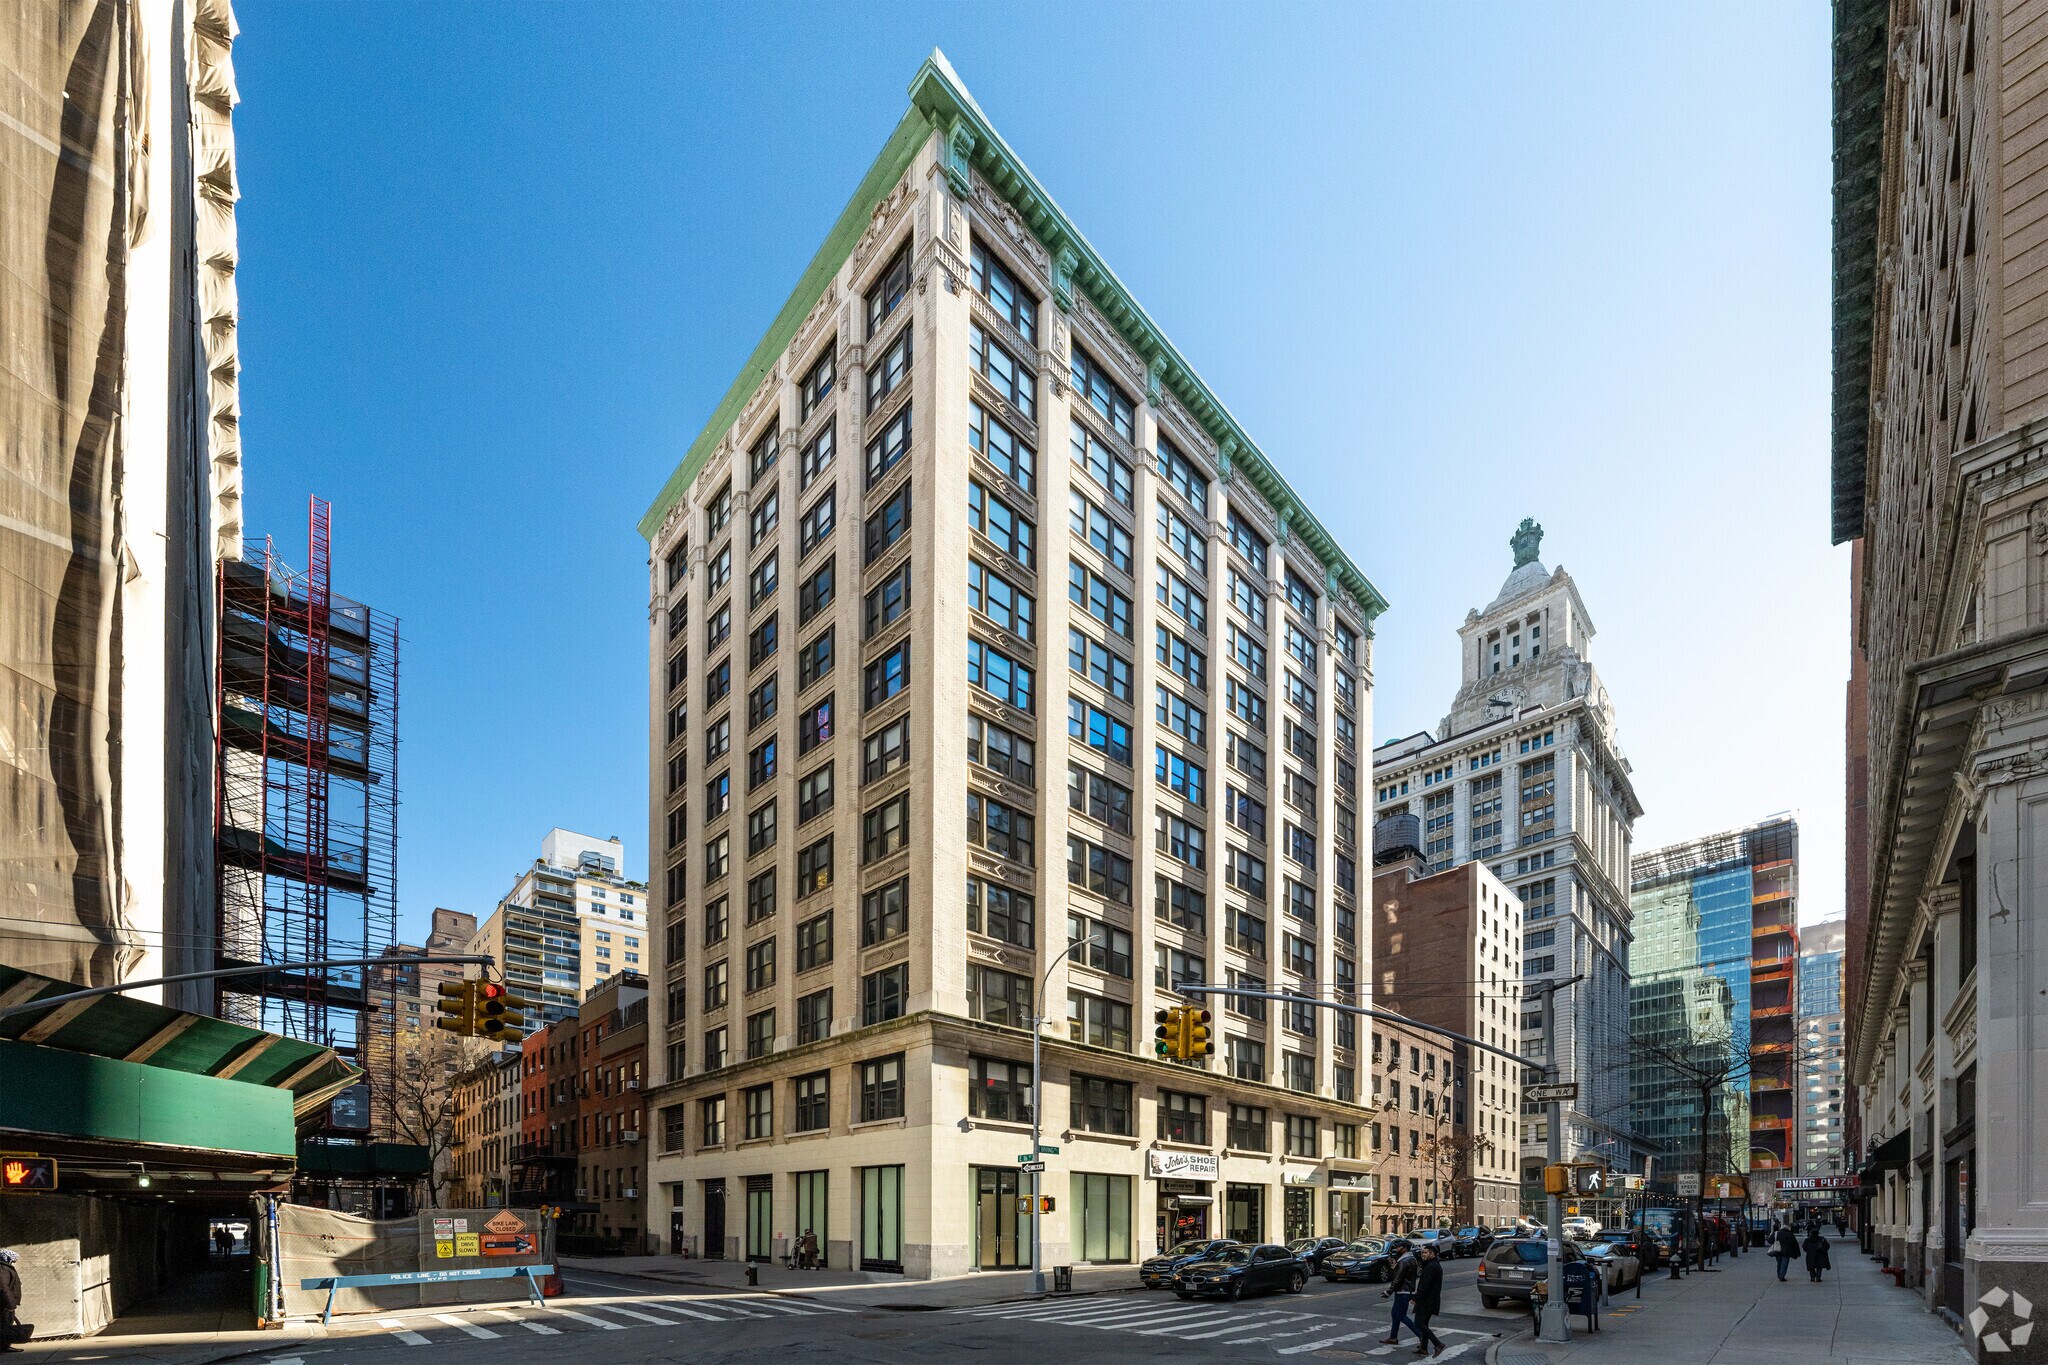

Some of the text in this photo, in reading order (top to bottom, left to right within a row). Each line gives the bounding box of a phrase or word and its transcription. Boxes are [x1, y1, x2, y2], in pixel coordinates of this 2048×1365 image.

[1530, 1090, 1548, 1098] ONE
[1164, 1154, 1189, 1171] John's
[1189, 1155, 1216, 1165] SHOE
[1189, 1164, 1216, 1173] REPAIR
[1782, 1178, 1854, 1189] IRVING PLAZA
